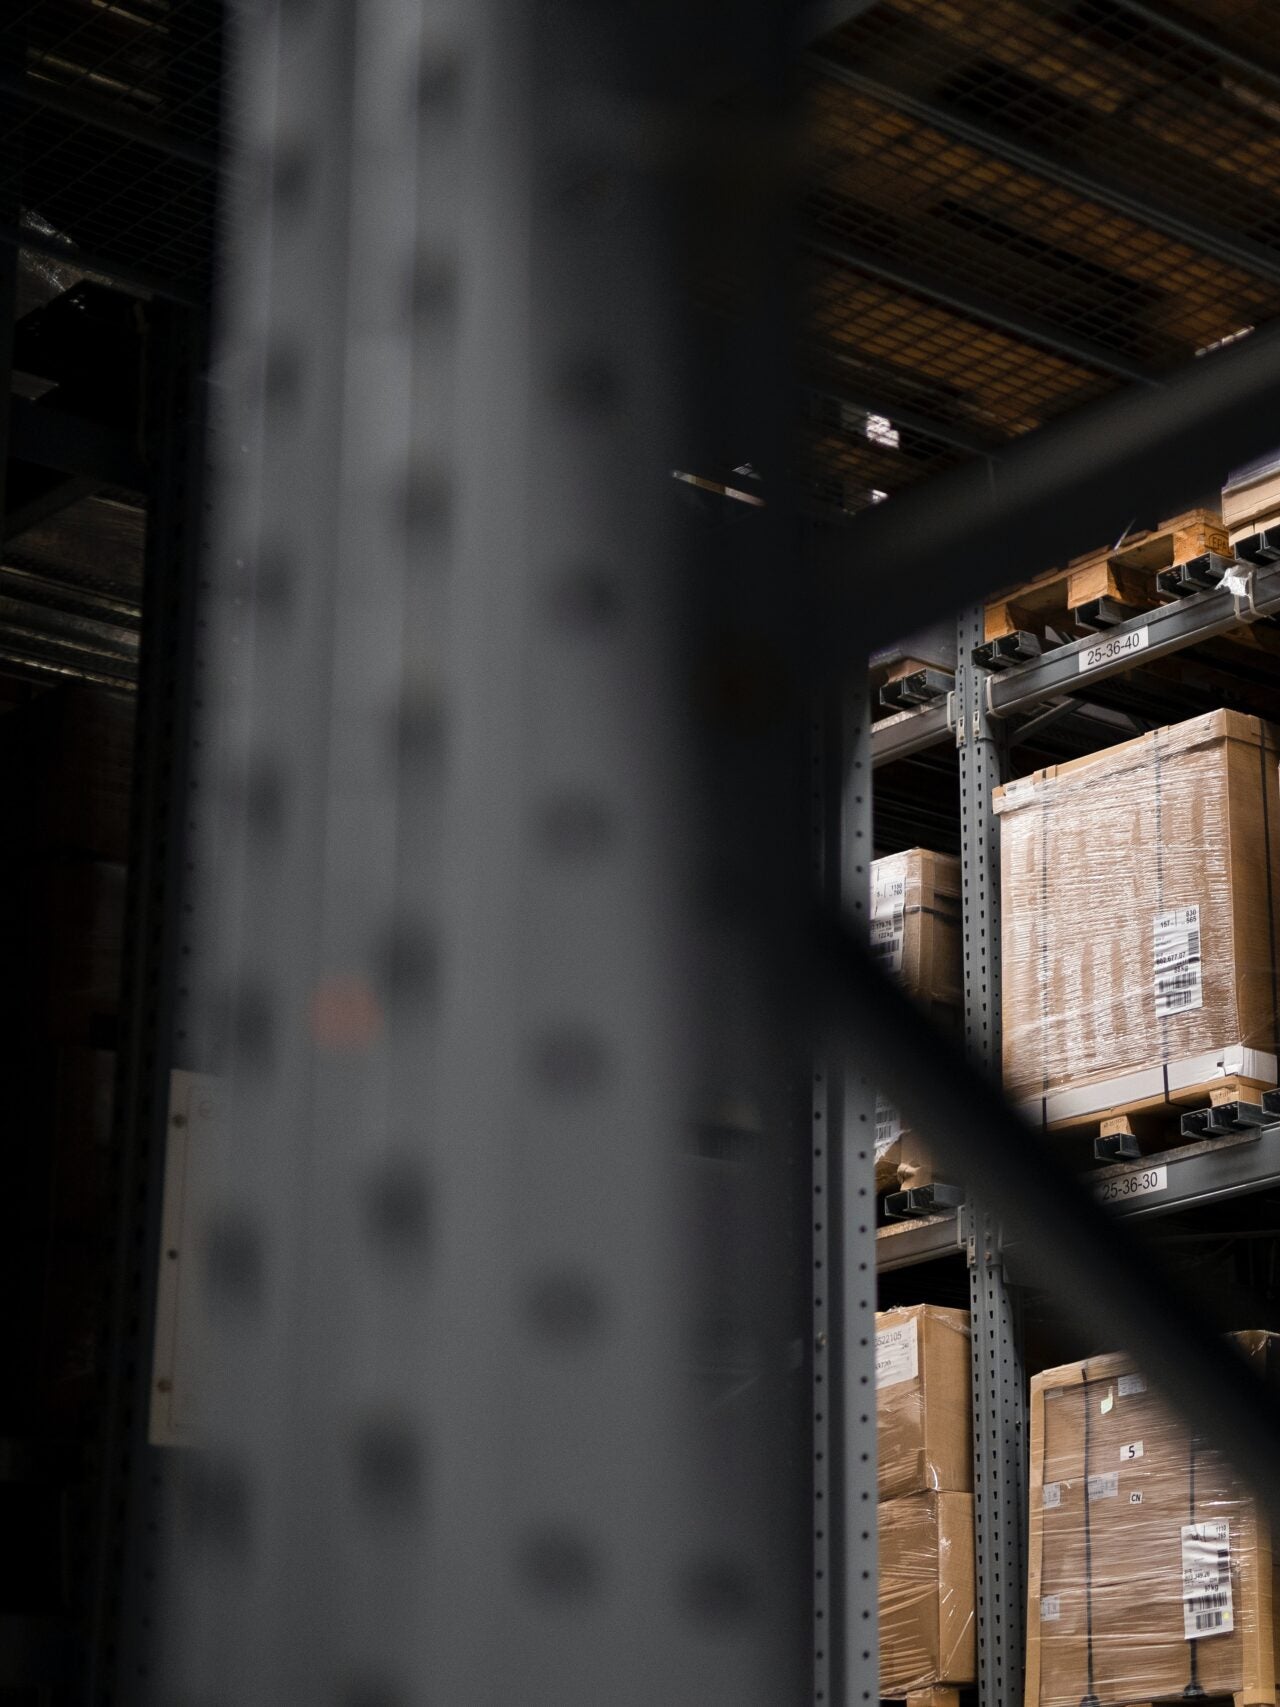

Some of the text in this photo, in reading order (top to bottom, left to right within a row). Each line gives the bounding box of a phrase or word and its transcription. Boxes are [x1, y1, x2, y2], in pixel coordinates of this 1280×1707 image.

[1087, 632, 1140, 666] 25-36-40
[1103, 1171, 1158, 1200] 25-36-30
[1128, 1445, 1136, 1459] 5
[1131, 1493, 1141, 1503] CN
